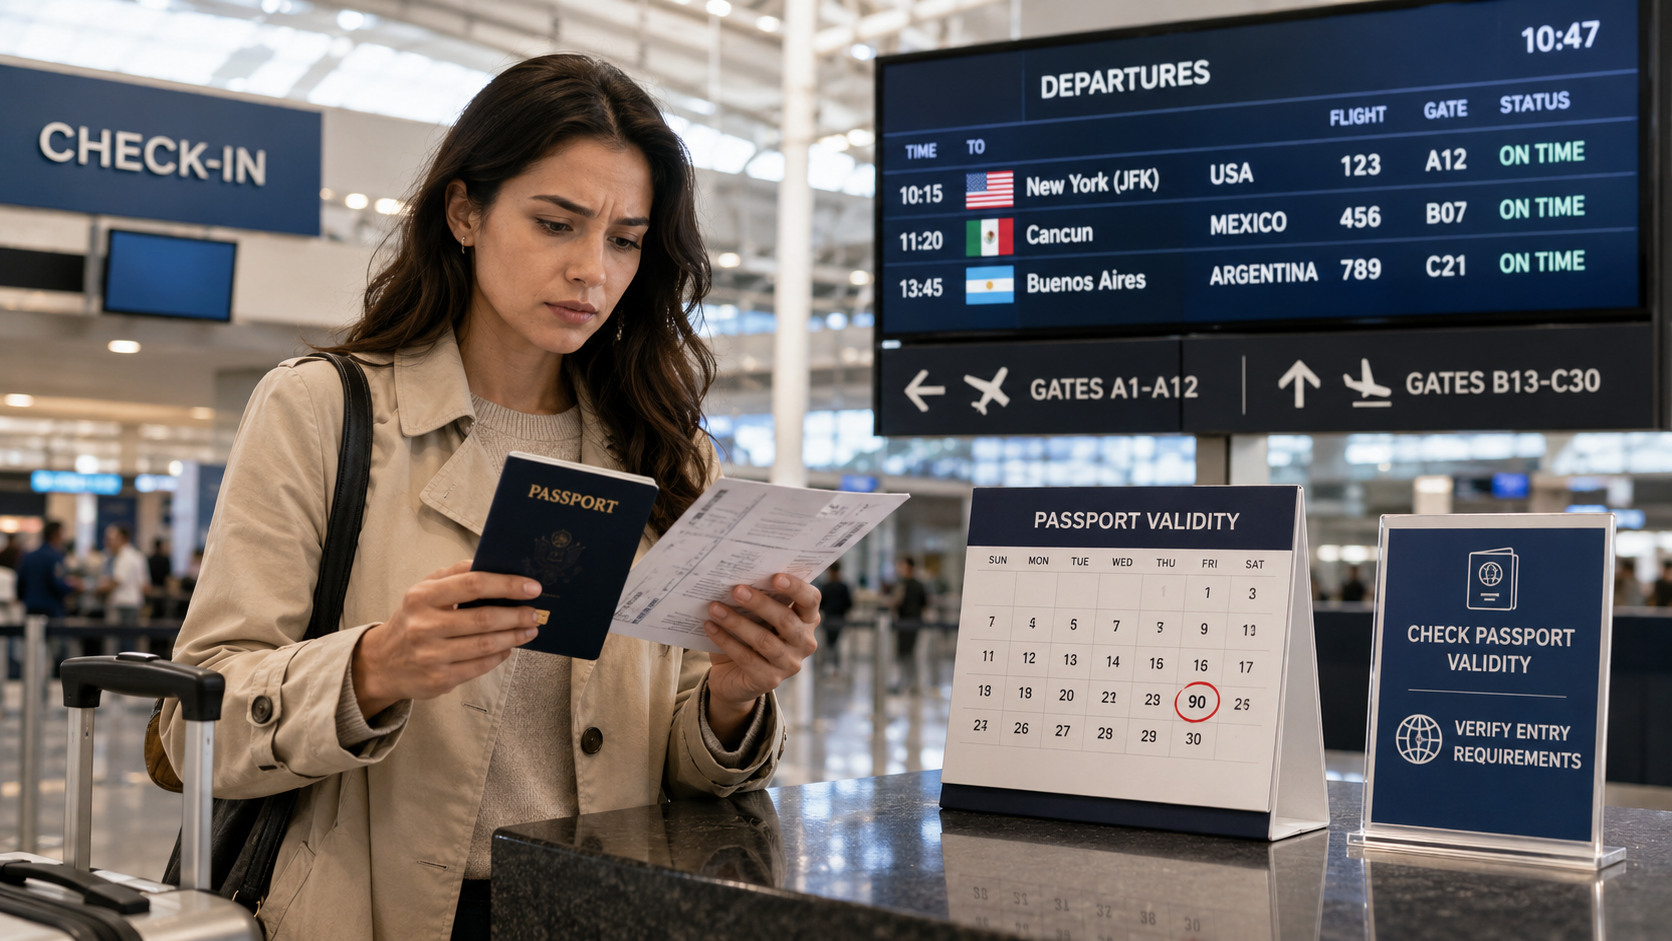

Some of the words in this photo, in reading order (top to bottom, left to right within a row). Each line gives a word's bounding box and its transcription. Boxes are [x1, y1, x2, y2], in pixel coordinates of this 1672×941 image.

[1522, 20, 1600, 53] 10:47
[1042, 60, 1210, 99] DEPARTURES
[906, 143, 936, 159] TIME
[967, 139, 985, 154] TO
[1330, 106, 1387, 126] FLIGHT
[1424, 99, 1467, 119] GATE
[1500, 91, 1570, 113] STATUS
[39, 121, 267, 186] CHECK-IN
[900, 184, 943, 204] 10:15
[1027, 177, 1065, 196] New
[1069, 172, 1109, 193] York
[1114, 168, 1159, 194] (JFK)
[1211, 162, 1253, 184] USA
[1341, 154, 1380, 176] 123
[1426, 148, 1466, 171] A12
[1500, 145, 1529, 165] ON
[1535, 141, 1584, 163] TIME
[900, 231, 943, 251] 11:20
[1027, 225, 1093, 244] Cancun
[1211, 211, 1286, 235] MEXICO
[1340, 206, 1381, 228] 456
[1427, 202, 1467, 224] B07
[1500, 199, 1529, 219] ON
[1535, 196, 1584, 217] TIME
[900, 278, 943, 298] 13:45
[1028, 274, 1093, 293] Buenos
[1099, 270, 1146, 290] Aires
[1210, 262, 1318, 285] ARGENTINA
[1341, 258, 1381, 280] 789
[1426, 255, 1465, 277] C21
[1500, 253, 1529, 273] ON
[1535, 250, 1585, 271] TIME
[1031, 378, 1103, 400] GATES
[1111, 376, 1198, 398] A1-A12
[1407, 371, 1484, 394] GATES
[1494, 369, 1600, 393] B13-C30
[527, 484, 619, 515] PASSPORT
[1035, 512, 1140, 529] PASSPORT
[1147, 513, 1239, 530] VALIDITY
[988, 555, 1008, 565] SUN
[1028, 556, 1050, 566] MON
[1071, 556, 1090, 567] TUE
[1112, 557, 1133, 567] WED
[1156, 558, 1176, 568] THU
[1201, 558, 1218, 569] FRI
[1245, 559, 1265, 569] SAT
[1205, 586, 1211, 599] 1
[1248, 587, 1257, 600] 3
[1113, 619, 1121, 632] 7
[1200, 622, 1209, 636] 9
[1408, 625, 1469, 643] CHECK
[1476, 627, 1575, 646] PASSPORT
[982, 650, 994, 662] 11
[1022, 651, 1036, 664] 12
[1064, 653, 1078, 666] 13
[1106, 655, 1120, 668] 14
[1239, 660, 1254, 674] 17
[1448, 654, 1531, 673] VALIDITY
[1058, 688, 1075, 702] 20
[1188, 694, 1207, 709] 90
[1013, 721, 1029, 735] 26
[1055, 724, 1071, 737] 27
[1185, 732, 1202, 746] 30
[1455, 720, 1511, 737] VERIFY
[1517, 724, 1570, 740] ENTRY
[1454, 746, 1581, 769] REQUIREMENTS
